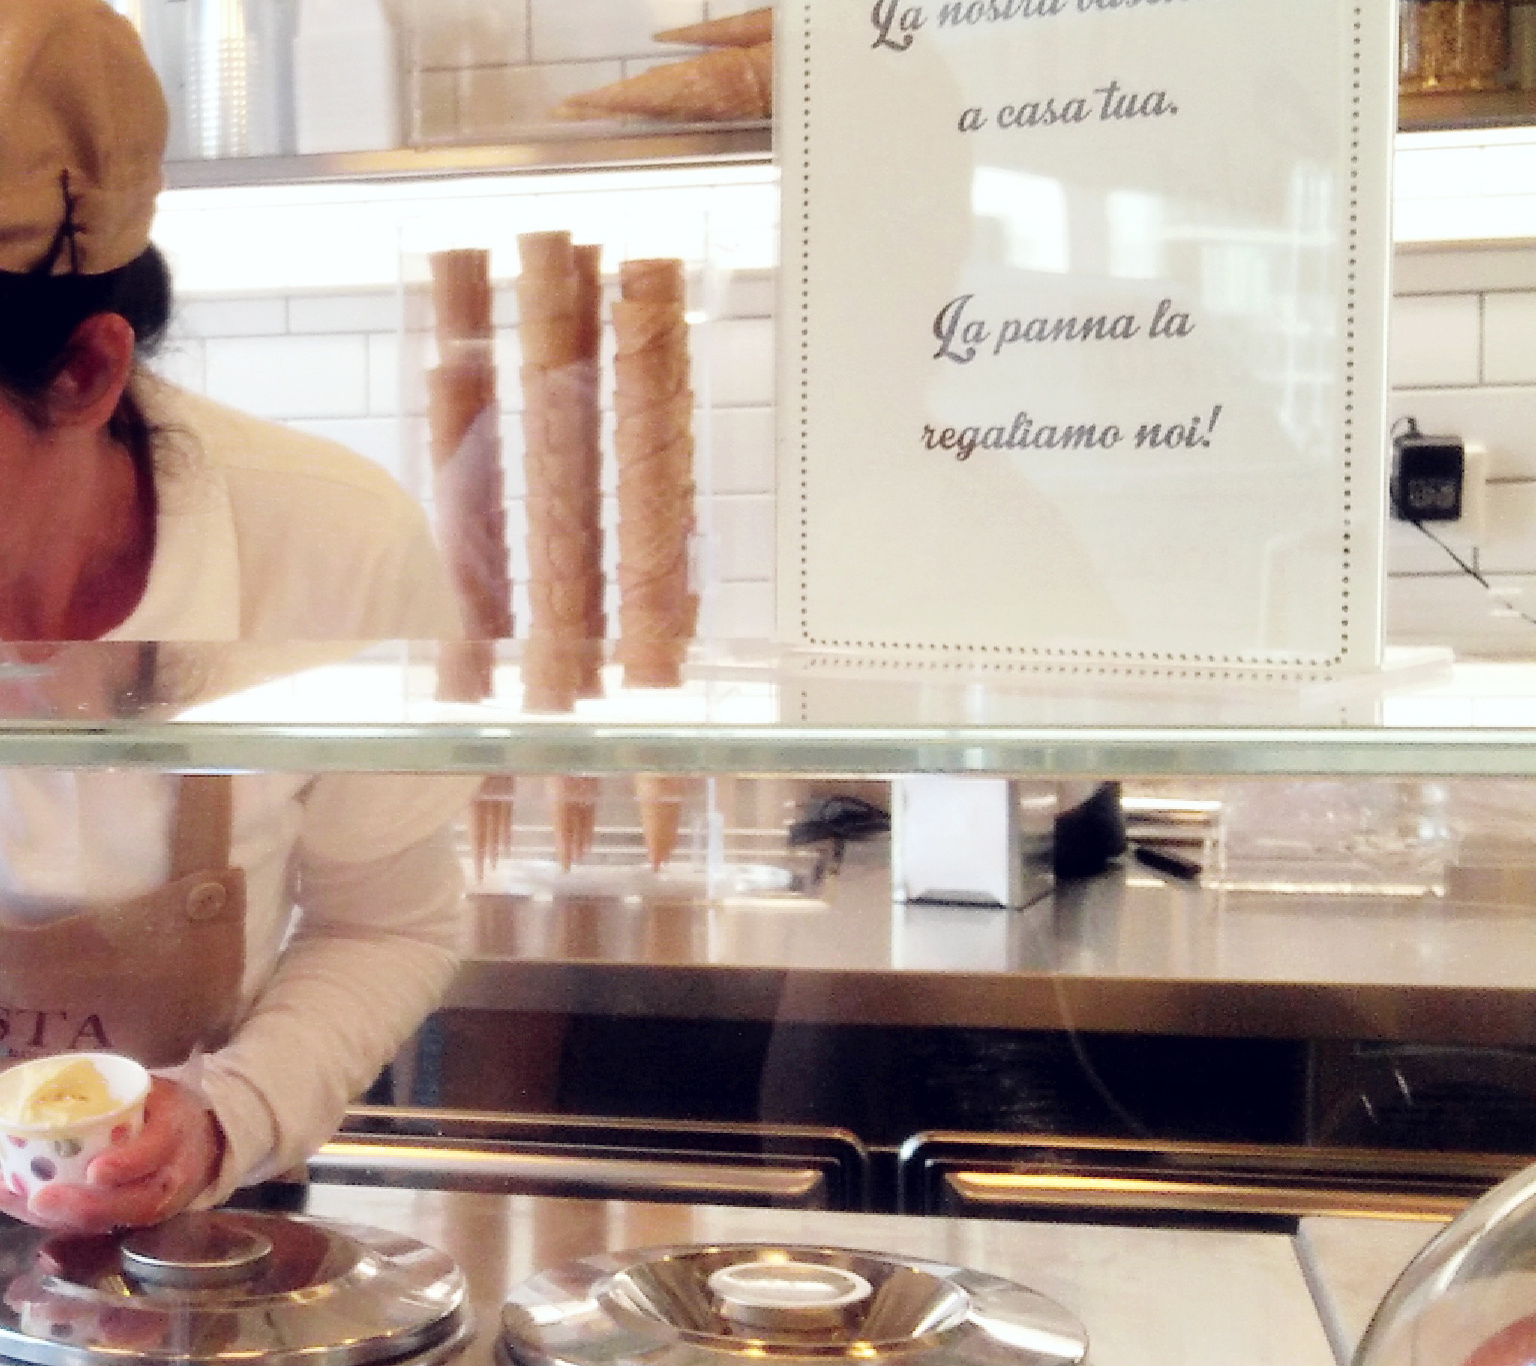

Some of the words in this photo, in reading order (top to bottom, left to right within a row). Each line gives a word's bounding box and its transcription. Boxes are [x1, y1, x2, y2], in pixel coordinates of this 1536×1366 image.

[957, 105, 987, 134] a
[996, 95, 1092, 132] casa
[1096, 79, 1181, 122] tua.
[931, 293, 991, 364] La
[992, 310, 1140, 355] panna
[1148, 298, 1195, 339] la
[921, 411, 1123, 462] regaliamo
[1134, 405, 1223, 449] noi!
